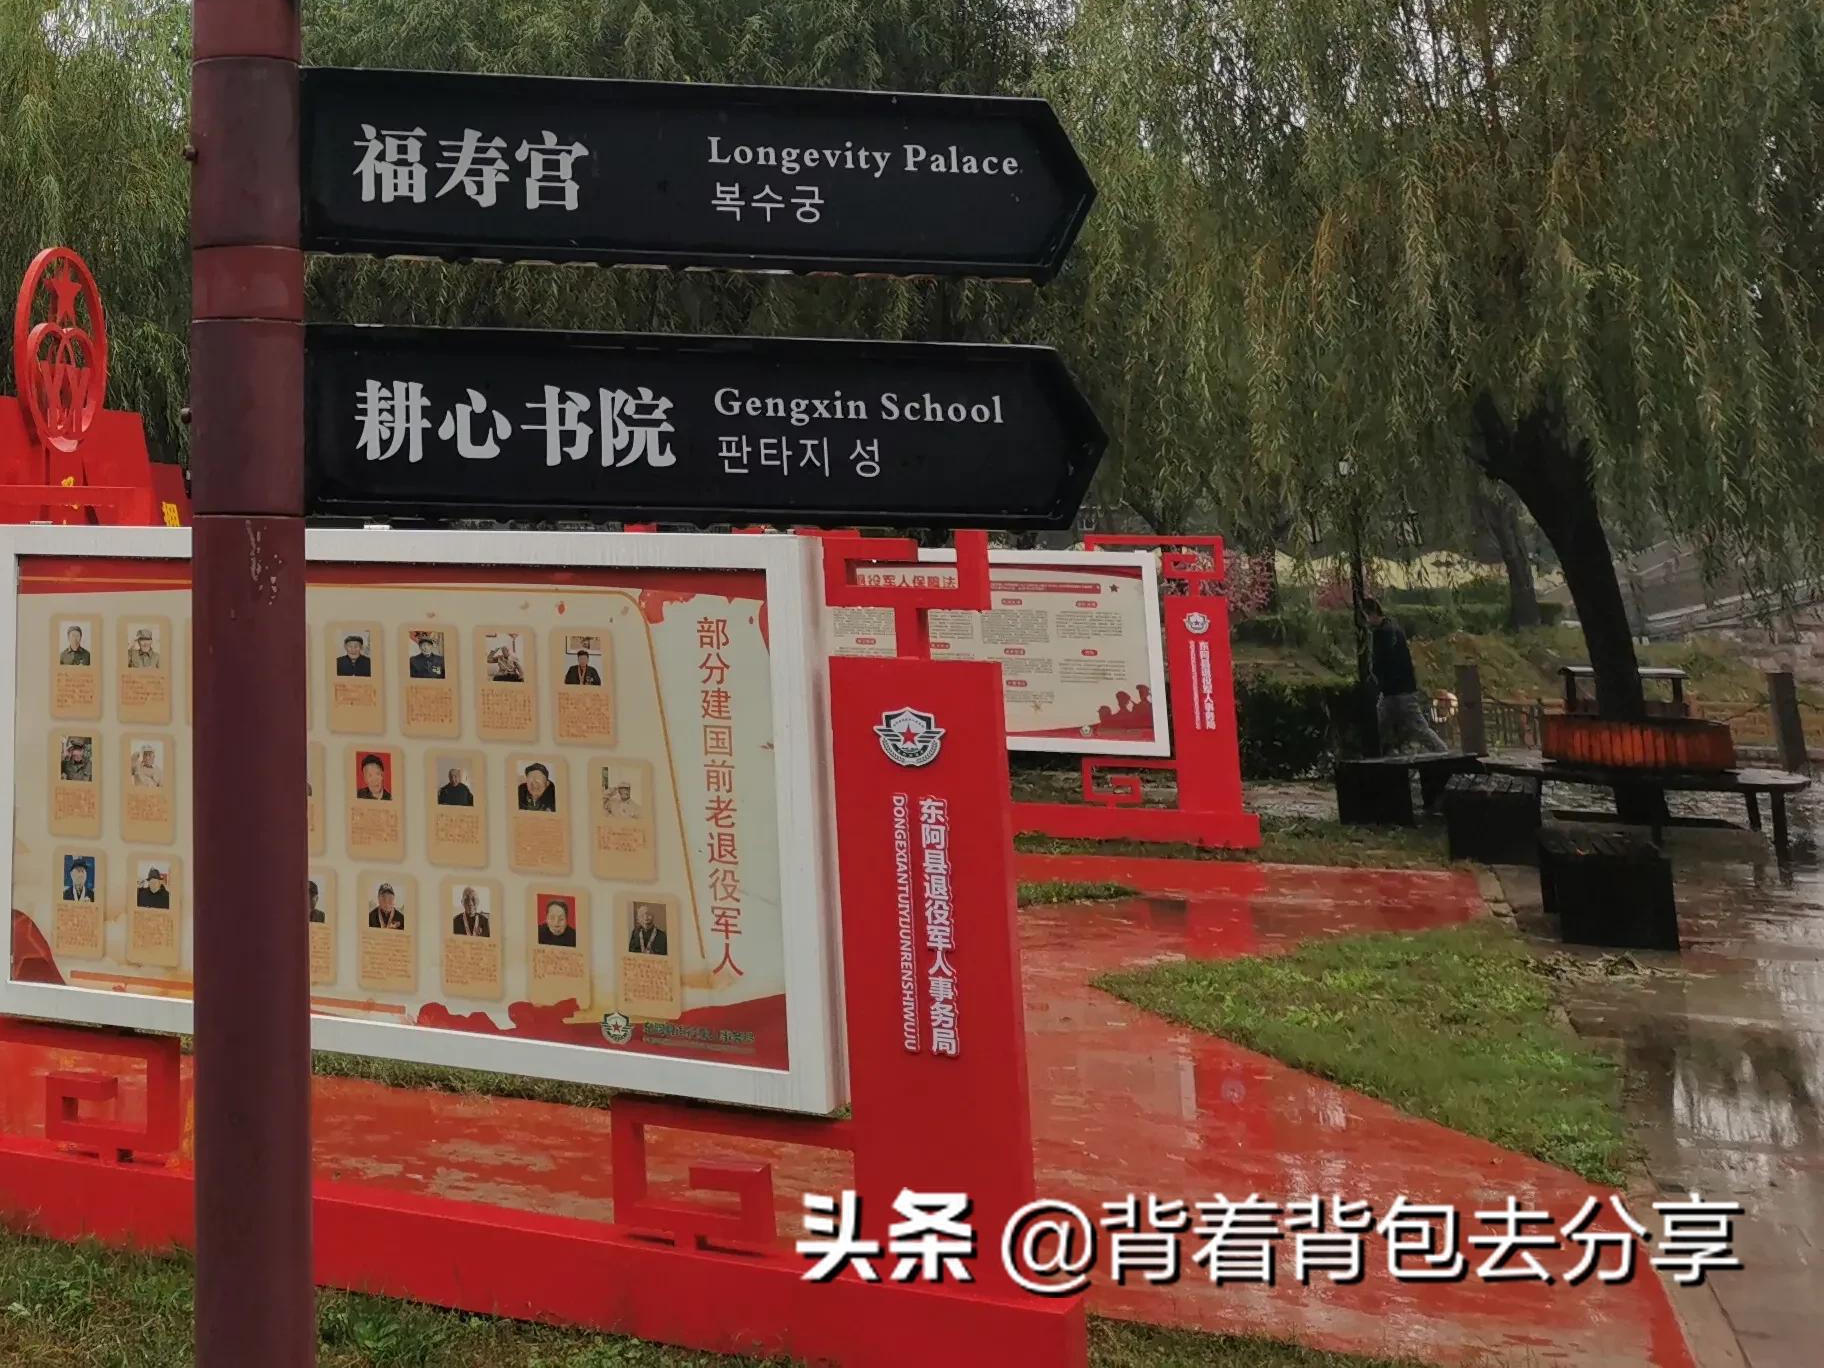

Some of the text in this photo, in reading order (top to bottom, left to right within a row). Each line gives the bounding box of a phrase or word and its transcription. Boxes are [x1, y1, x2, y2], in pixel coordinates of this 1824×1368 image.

[353, 123, 589, 211] 福寿宫
[707, 136, 1018, 178] Longevity Palace
[711, 182, 826, 224] 복수궁
[354, 379, 677, 468] 耕心书院
[714, 387, 1005, 427] Gengxin School
[717, 434, 882, 478] 판타지 성
[696, 617, 744, 978] 部分建国前老退役军人
[918, 797, 958, 1055] 东阿县退役军人事务局
